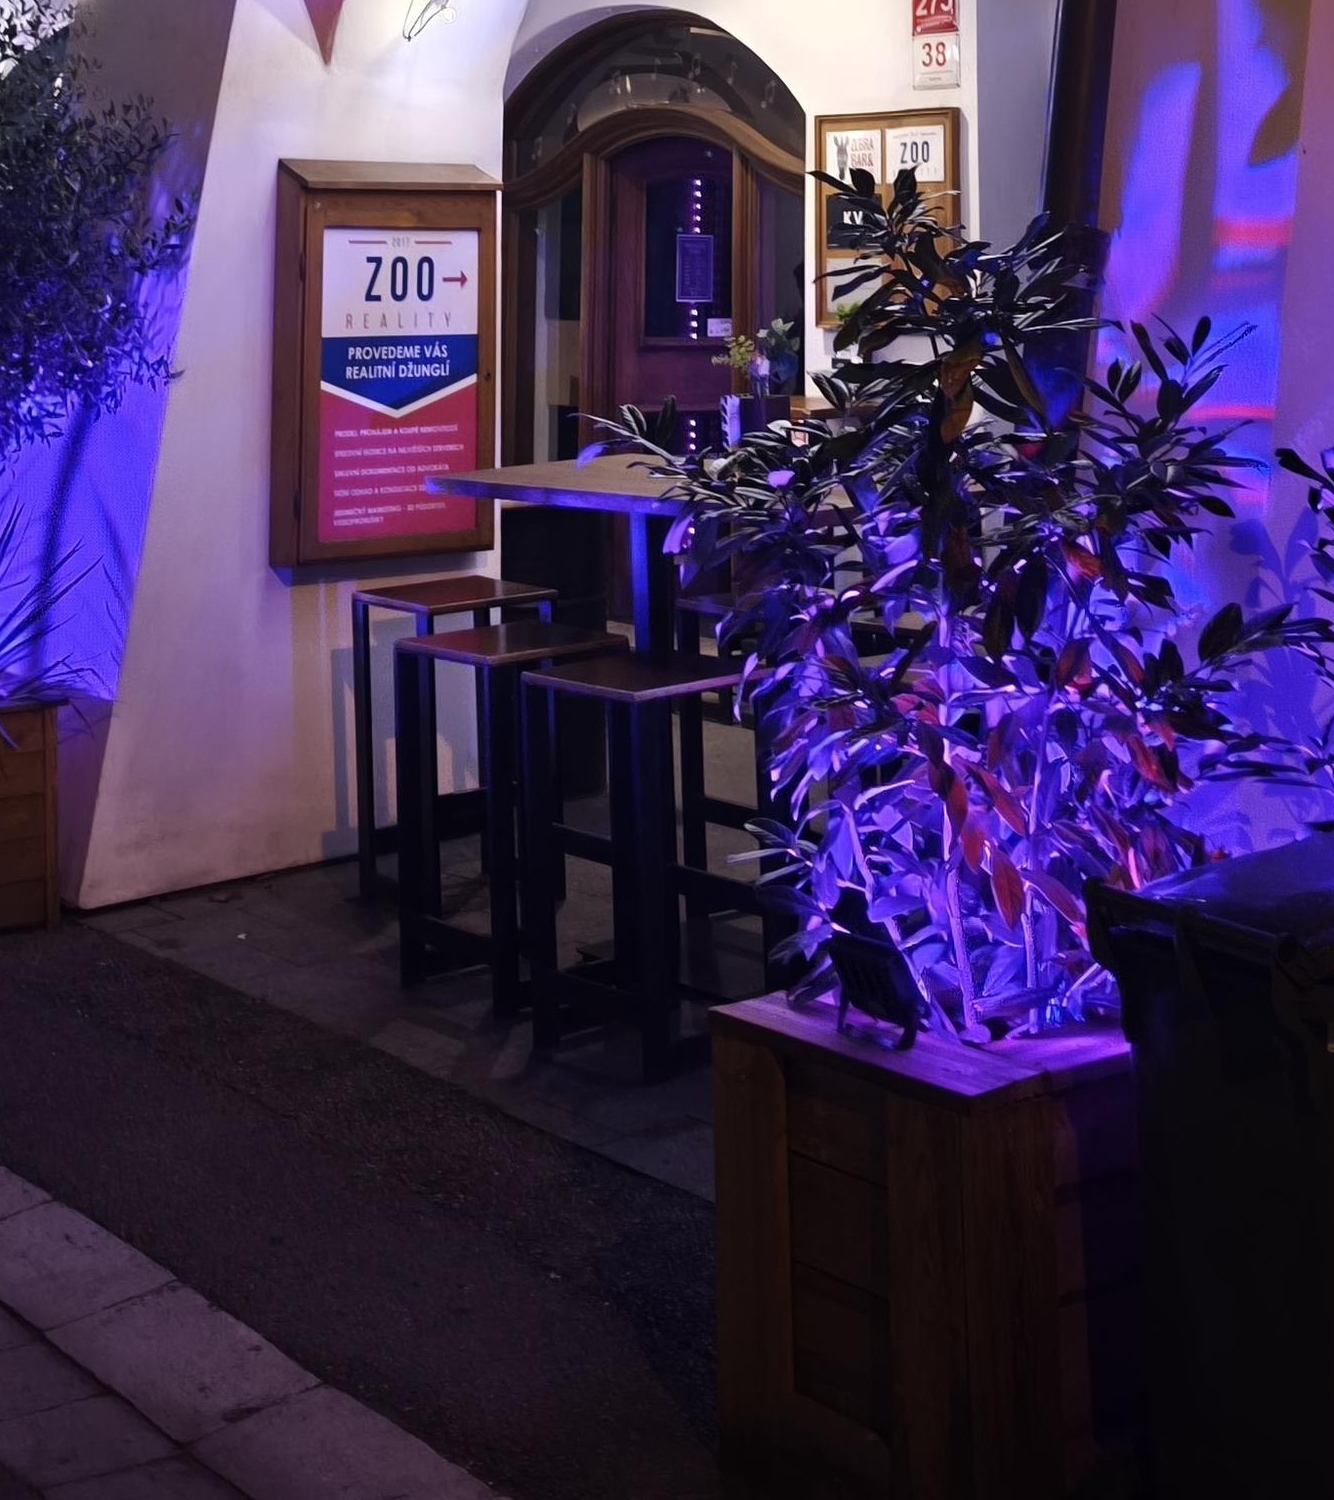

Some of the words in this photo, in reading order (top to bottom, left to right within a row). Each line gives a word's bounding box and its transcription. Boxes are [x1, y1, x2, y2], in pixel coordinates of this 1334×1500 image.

[922, 42, 946, 67] 38
[900, 141, 930, 164] ZOO
[365, 256, 435, 302] ZOO
[346, 312, 451, 329] REALITY
[348, 346, 420, 360] PROVEDEME
[424, 341, 449, 358] VÁS
[346, 362, 396, 379] REALITNÍ
[398, 360, 450, 377] DŽUNGLÍ
